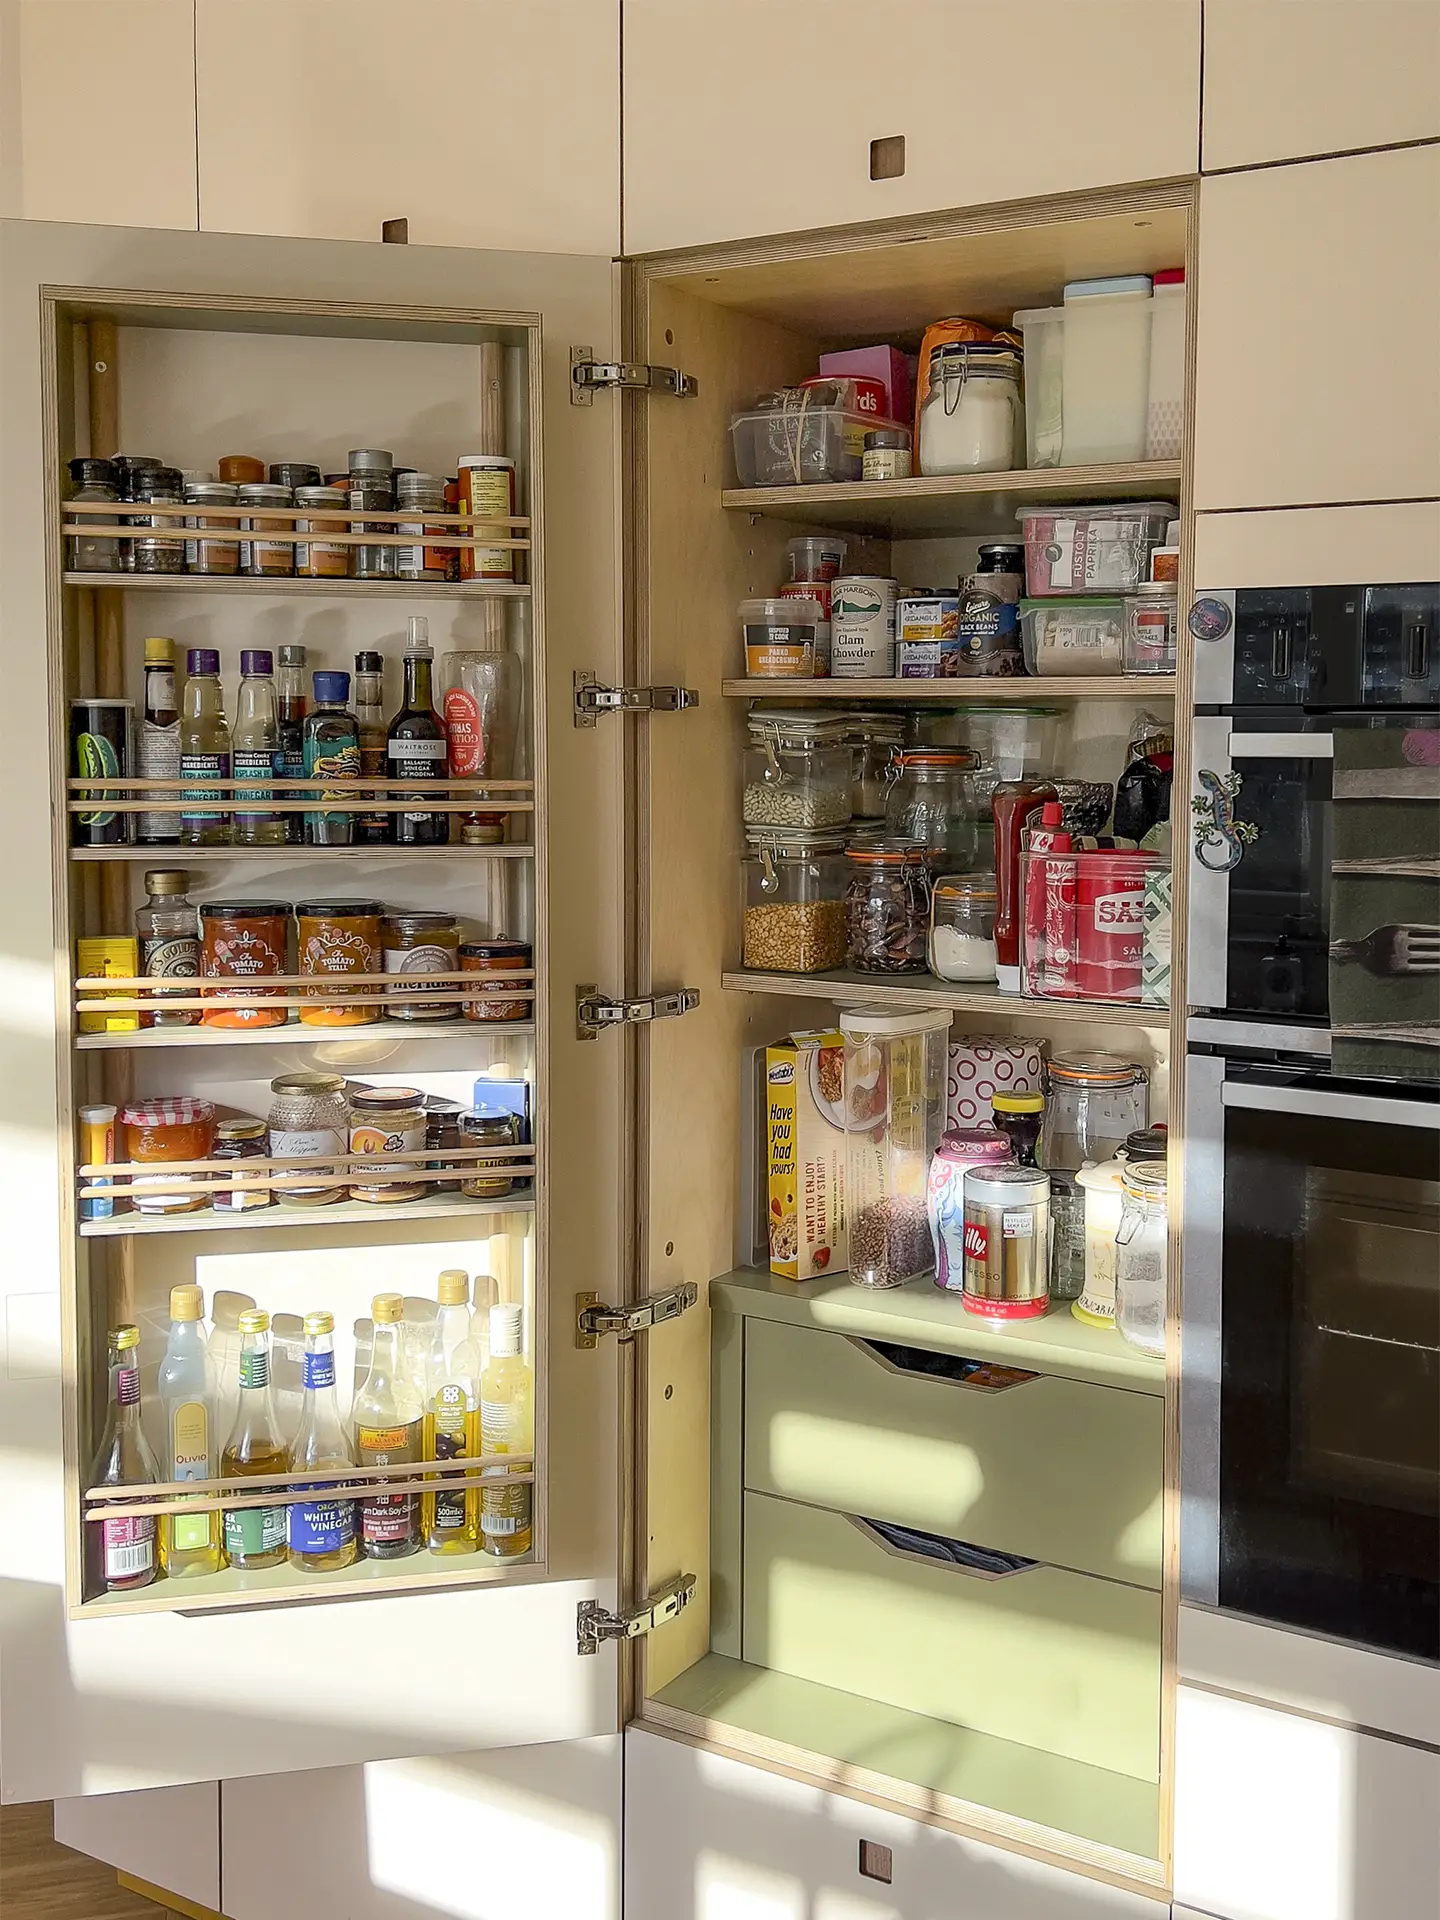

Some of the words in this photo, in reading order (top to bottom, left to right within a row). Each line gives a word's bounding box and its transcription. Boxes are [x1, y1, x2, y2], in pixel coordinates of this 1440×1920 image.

[768, 419, 800, 432] SUGA
[1086, 529, 1098, 578] PAPRIKA
[838, 634, 864, 645] Clam
[832, 647, 876, 658] Chowder
[240, 790, 270, 800] VINEGAR
[1098, 900, 1145, 923] SAX
[162, 943, 197, 959] GOLDE
[1122, 946, 1143, 956] SAL
[229, 960, 264, 969] TOMATO
[321, 957, 356, 966] TOMATO
[328, 964, 349, 972] STALL
[236, 967, 257, 975] STALL
[769, 1066, 795, 1082] Weetabix
[770, 1104, 793, 1121] Have
[771, 1124, 791, 1143] you
[772, 1142, 793, 1160] had
[770, 1162, 795, 1177] yours?
[804, 1161, 815, 1194] ENJOY
[816, 1156, 827, 1190] START?
[805, 1197, 815, 1211] TO
[816, 1194, 827, 1235] HEALTHY
[805, 1214, 816, 1244] WANT
[965, 1227, 987, 1256] illy
[303, 1511, 336, 1523] WHITE
[338, 1502, 356, 1518] WINE
[317, 1500, 347, 1512] ORGAN
[372, 1507, 389, 1516] Dark
[388, 1506, 402, 1517] Soy
[310, 1514, 352, 1532] VINEGAR
